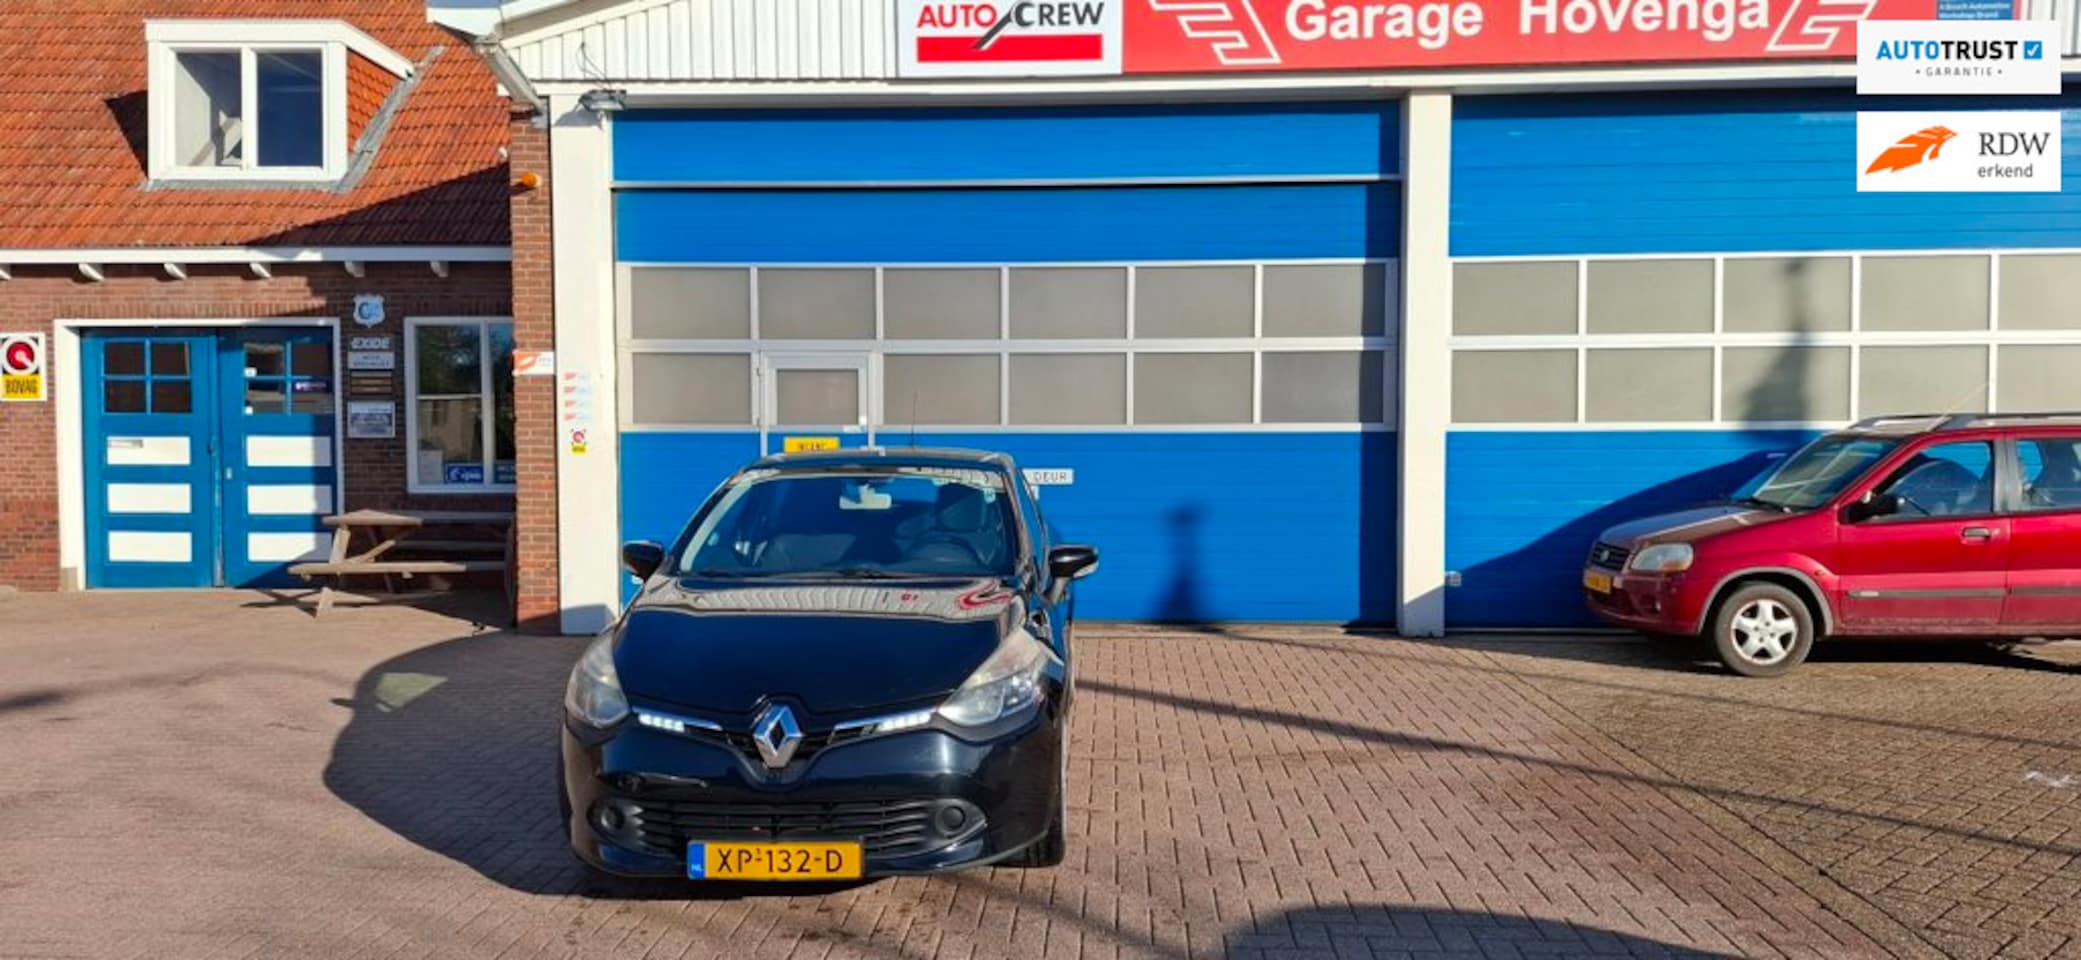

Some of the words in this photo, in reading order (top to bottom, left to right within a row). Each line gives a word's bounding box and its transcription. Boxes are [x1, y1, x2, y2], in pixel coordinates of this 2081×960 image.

[917, 4, 998, 28] AUTO
[1014, 2, 1105, 27] CREW
[1285, 0, 1484, 49] Garage
[1519, 0, 1769, 42] Hovenga
[5, 378, 38, 395] BOVAG
[1032, 470, 1067, 482] DEUR
